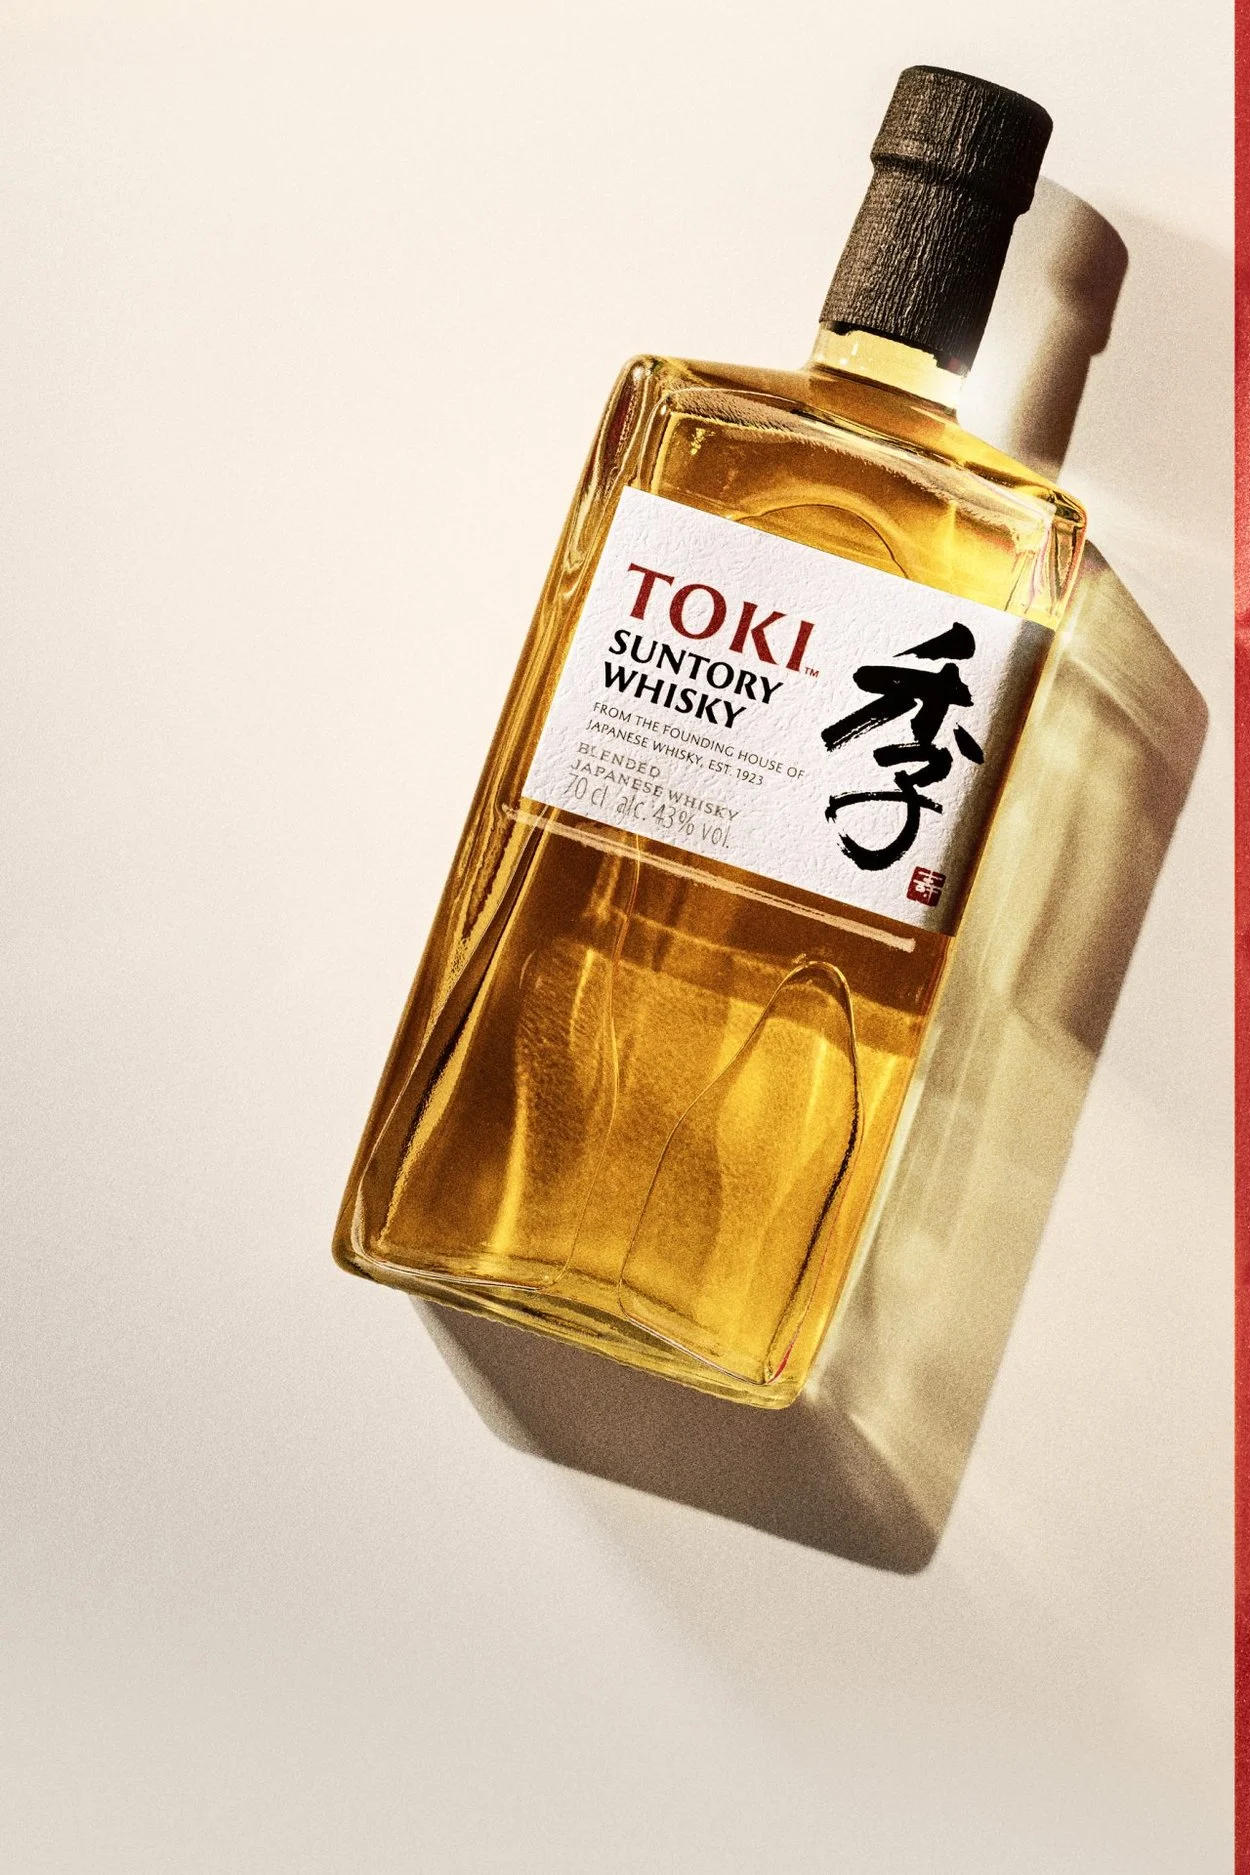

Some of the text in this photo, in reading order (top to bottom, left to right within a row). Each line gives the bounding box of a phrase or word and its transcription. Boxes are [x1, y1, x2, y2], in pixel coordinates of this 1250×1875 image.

[627, 562, 815, 672] TOKI
[604, 661, 747, 728] WHISKY
[608, 629, 784, 704] SUNTORY
[578, 741, 661, 778] BLENDED
[586, 719, 764, 786] JAPANESE WHISKY, EST. 1923
[593, 701, 805, 780] FROM THE FOUNDING HOUSE OF
[821, 621, 985, 871] 季
[563, 772, 730, 849] 70 cl alc. 43% vol.
[570, 759, 740, 822] JAPANESE WHISKY
